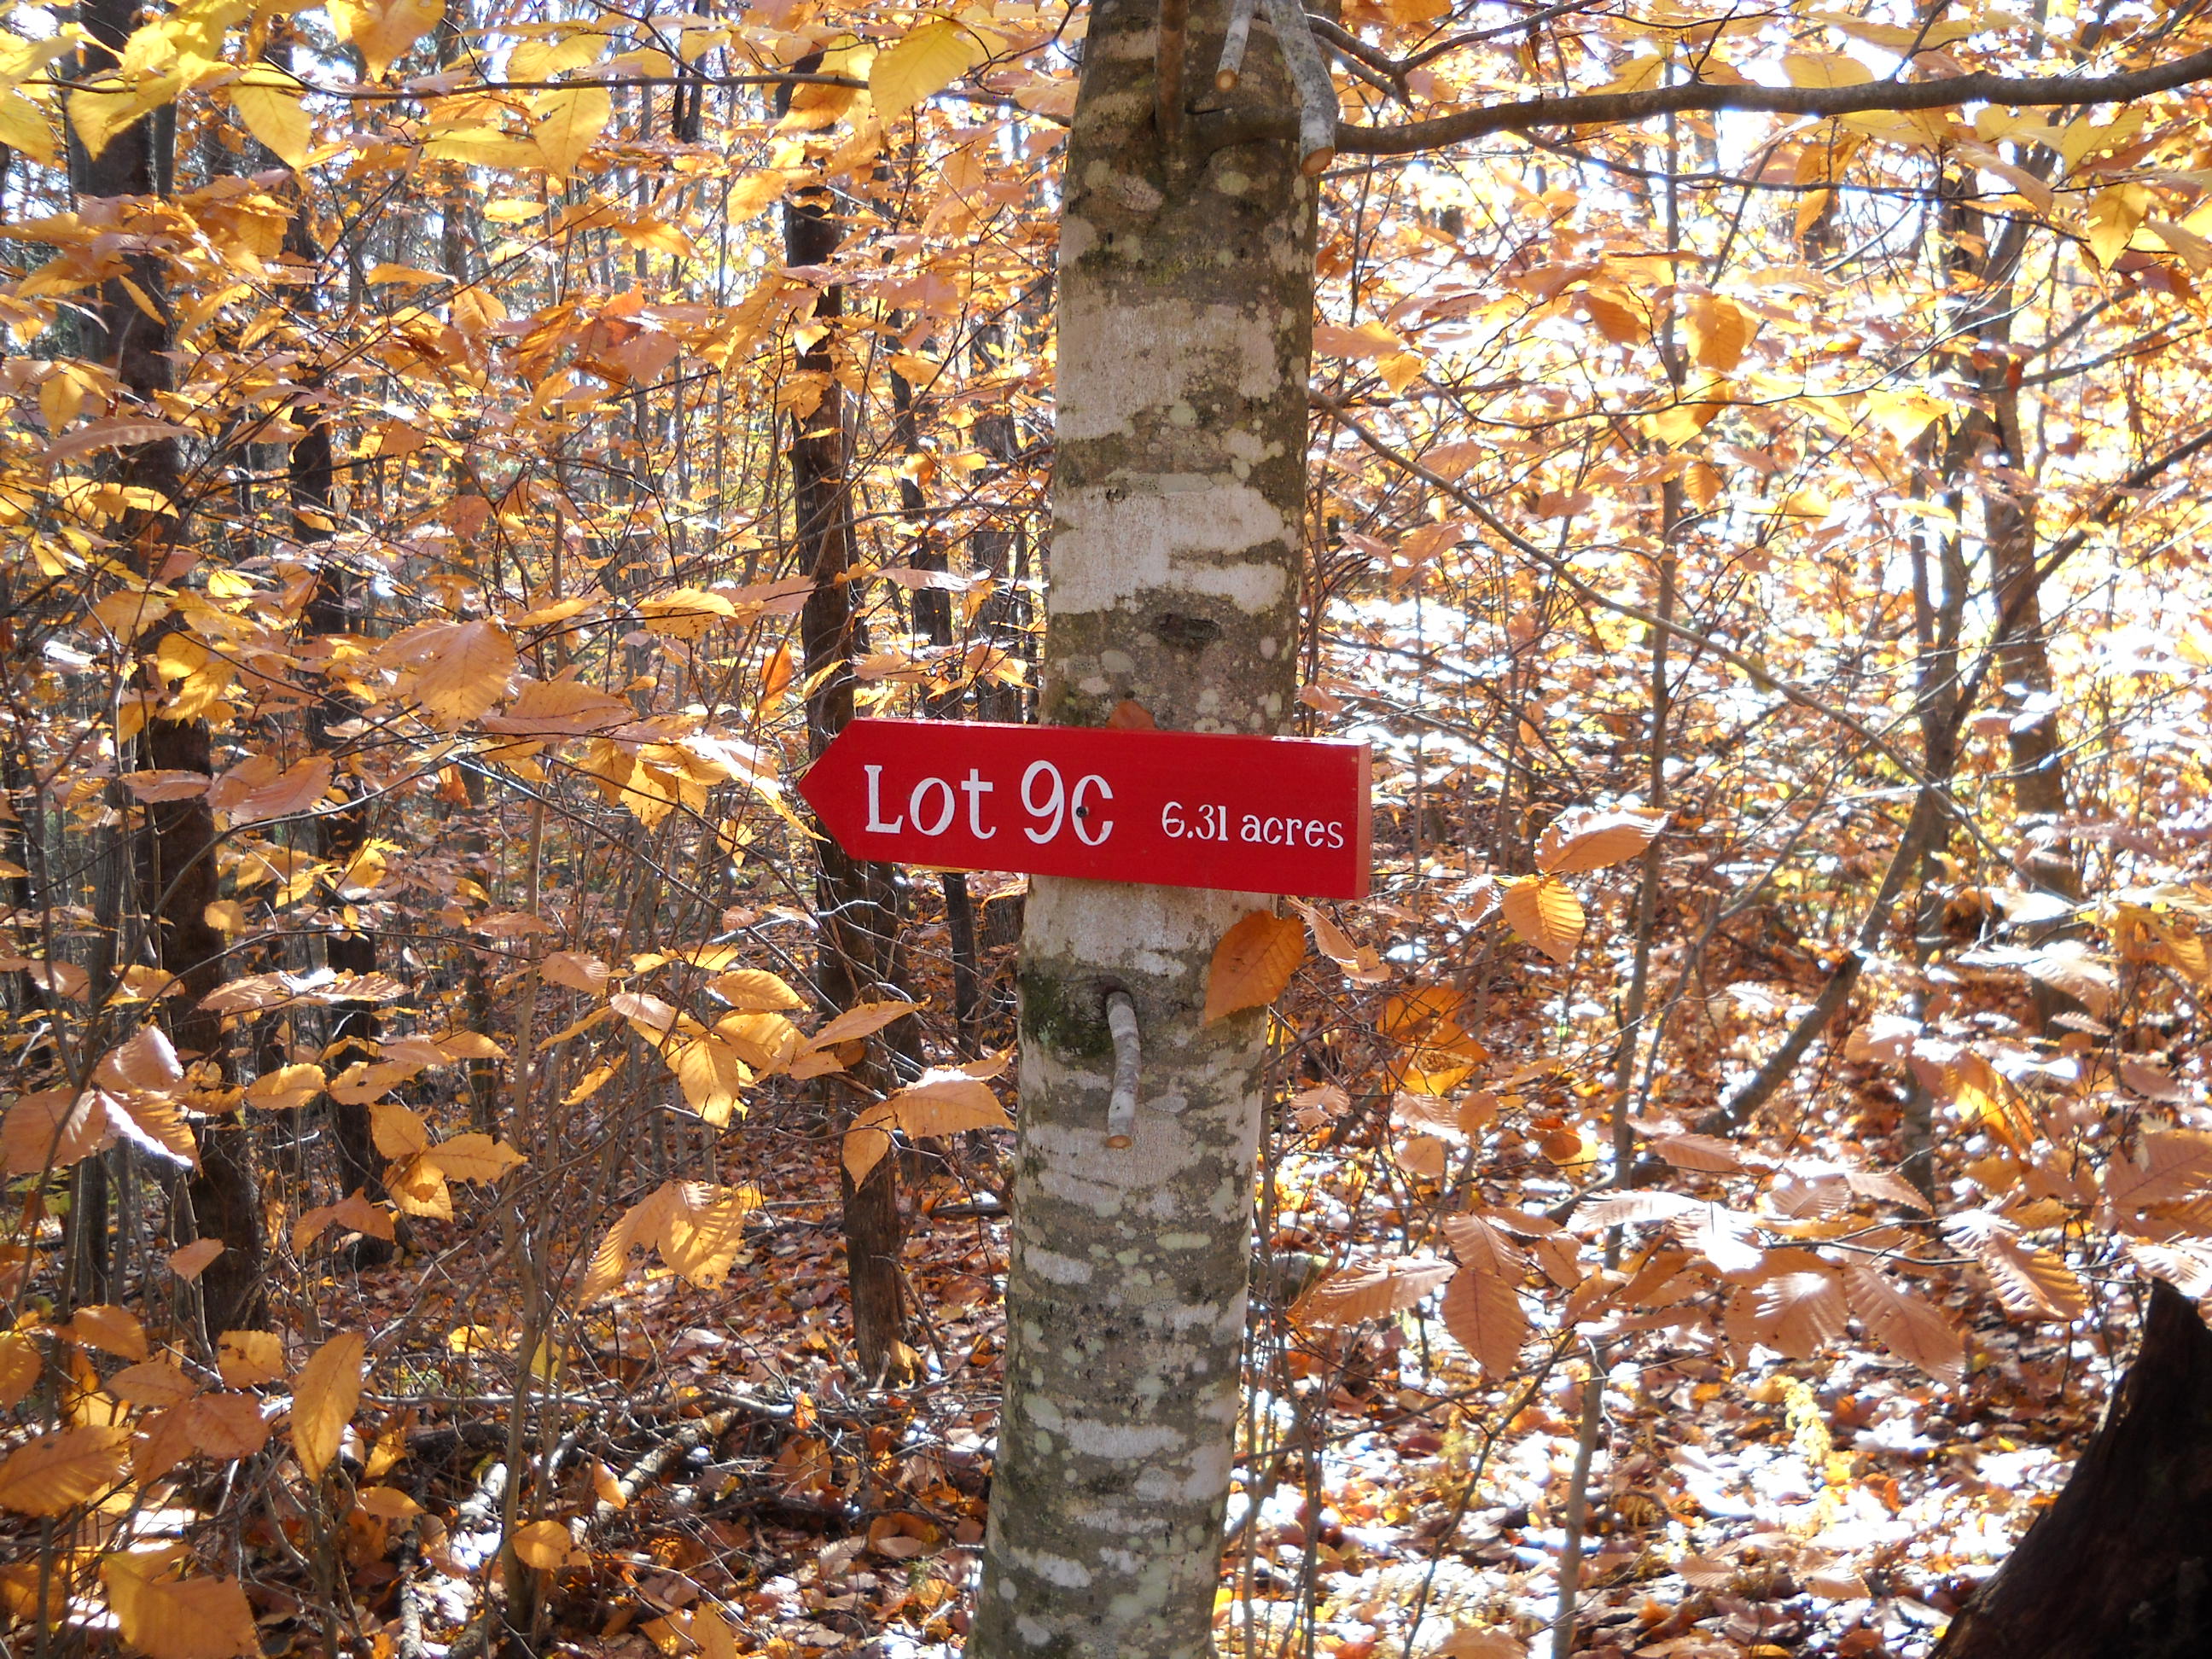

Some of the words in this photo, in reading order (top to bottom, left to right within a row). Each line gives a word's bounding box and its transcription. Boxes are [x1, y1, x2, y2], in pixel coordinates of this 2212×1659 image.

[864, 765, 997, 840] Lot
[1161, 801, 1229, 841] 6.31
[1240, 814, 1345, 850] acres
